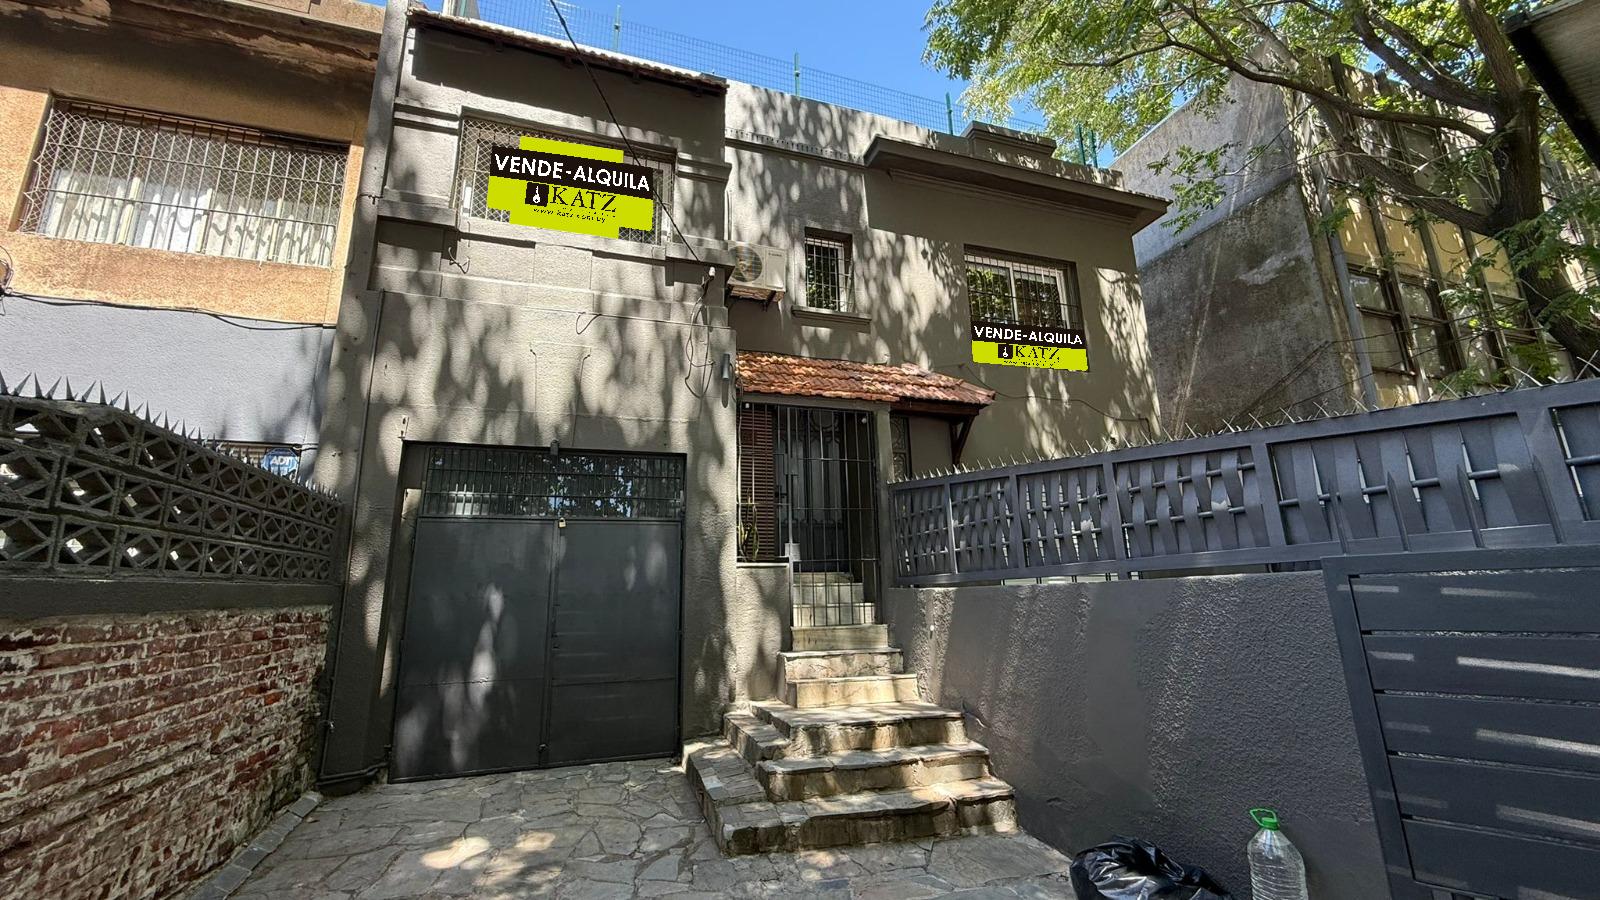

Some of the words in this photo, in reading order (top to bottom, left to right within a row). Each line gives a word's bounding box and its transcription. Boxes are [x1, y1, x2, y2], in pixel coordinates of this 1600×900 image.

[494, 153, 650, 191] VENDE-ALQUILA
[550, 185, 617, 213] KATZ
[533, 208, 606, 224] wwwkatzcomuy
[973, 325, 1083, 345] VENDE-ALQUILA
[1015, 345, 1060, 360] KATZ
[270, 455, 292, 466] ADT
